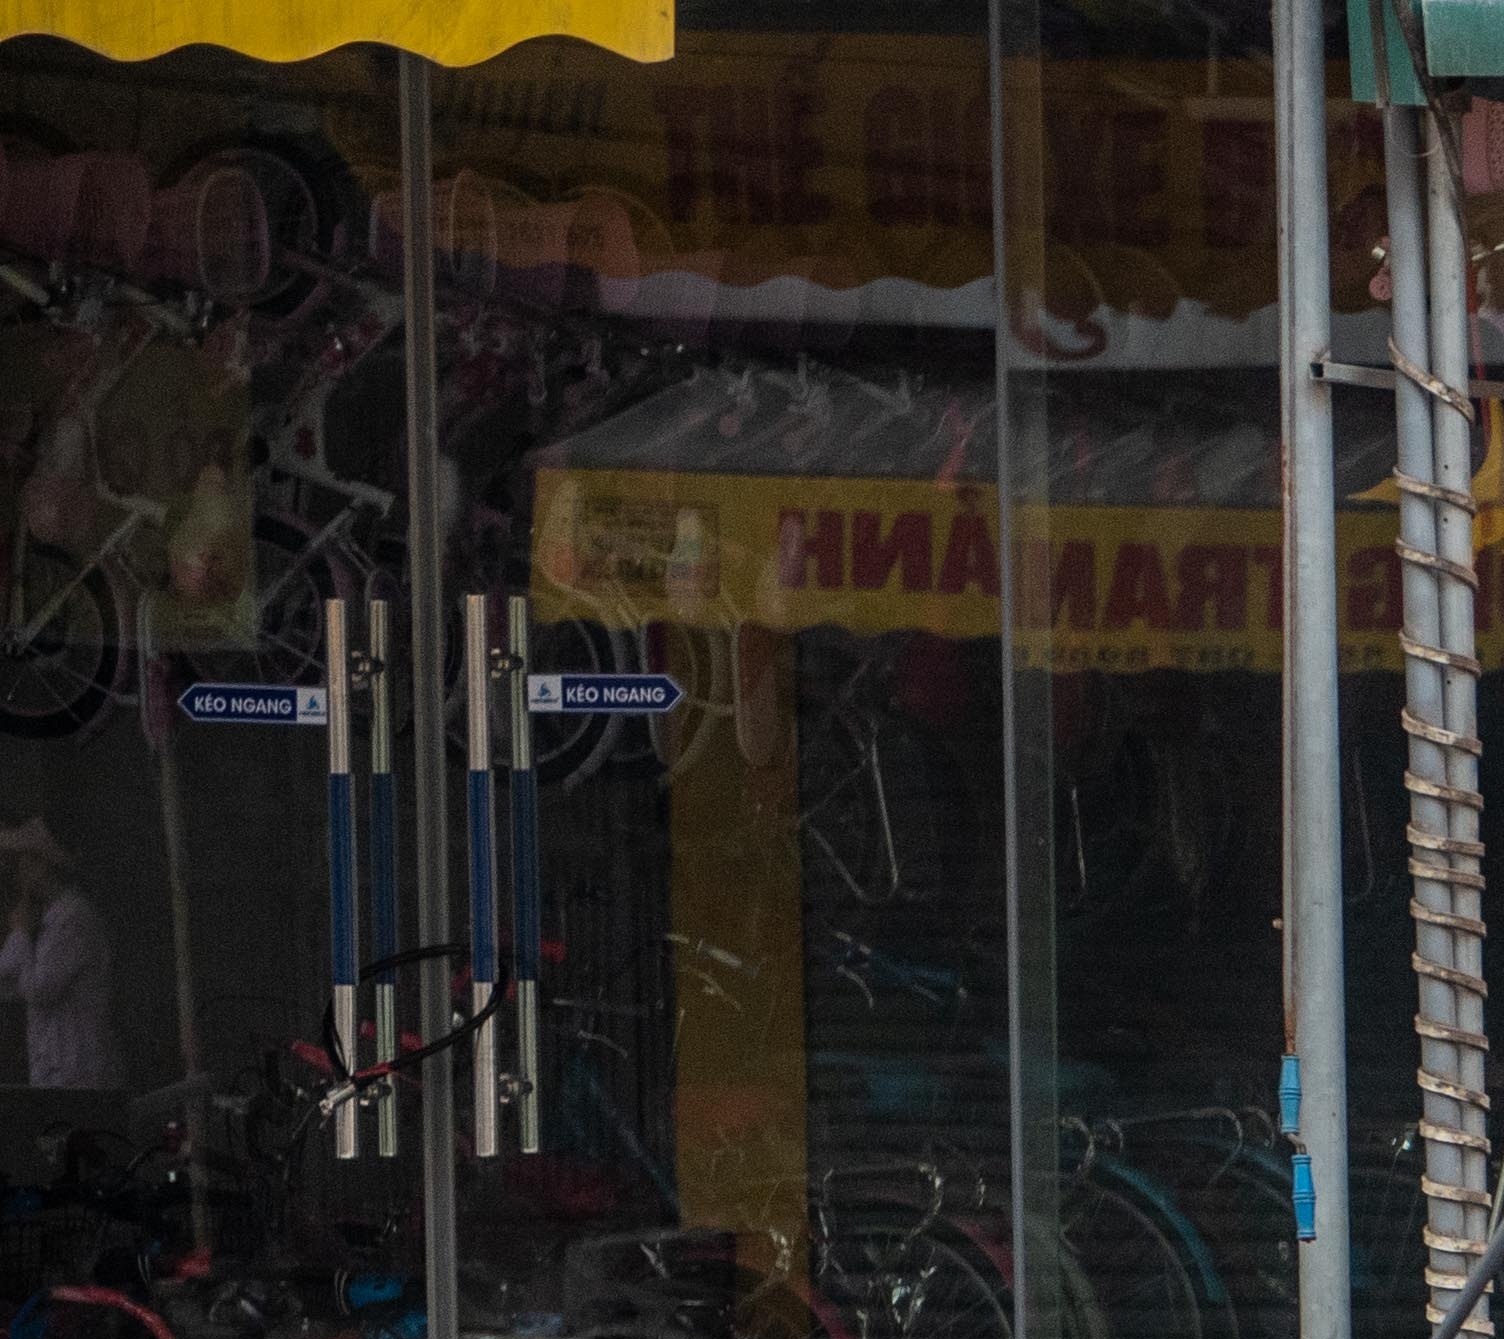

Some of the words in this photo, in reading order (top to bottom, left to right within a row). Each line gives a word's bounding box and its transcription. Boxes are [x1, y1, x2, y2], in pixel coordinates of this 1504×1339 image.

[194, 692, 226, 713] KÉO
[230, 696, 292, 715] NGANG
[566, 683, 599, 703] KÉO
[603, 686, 666, 704] NGANG
